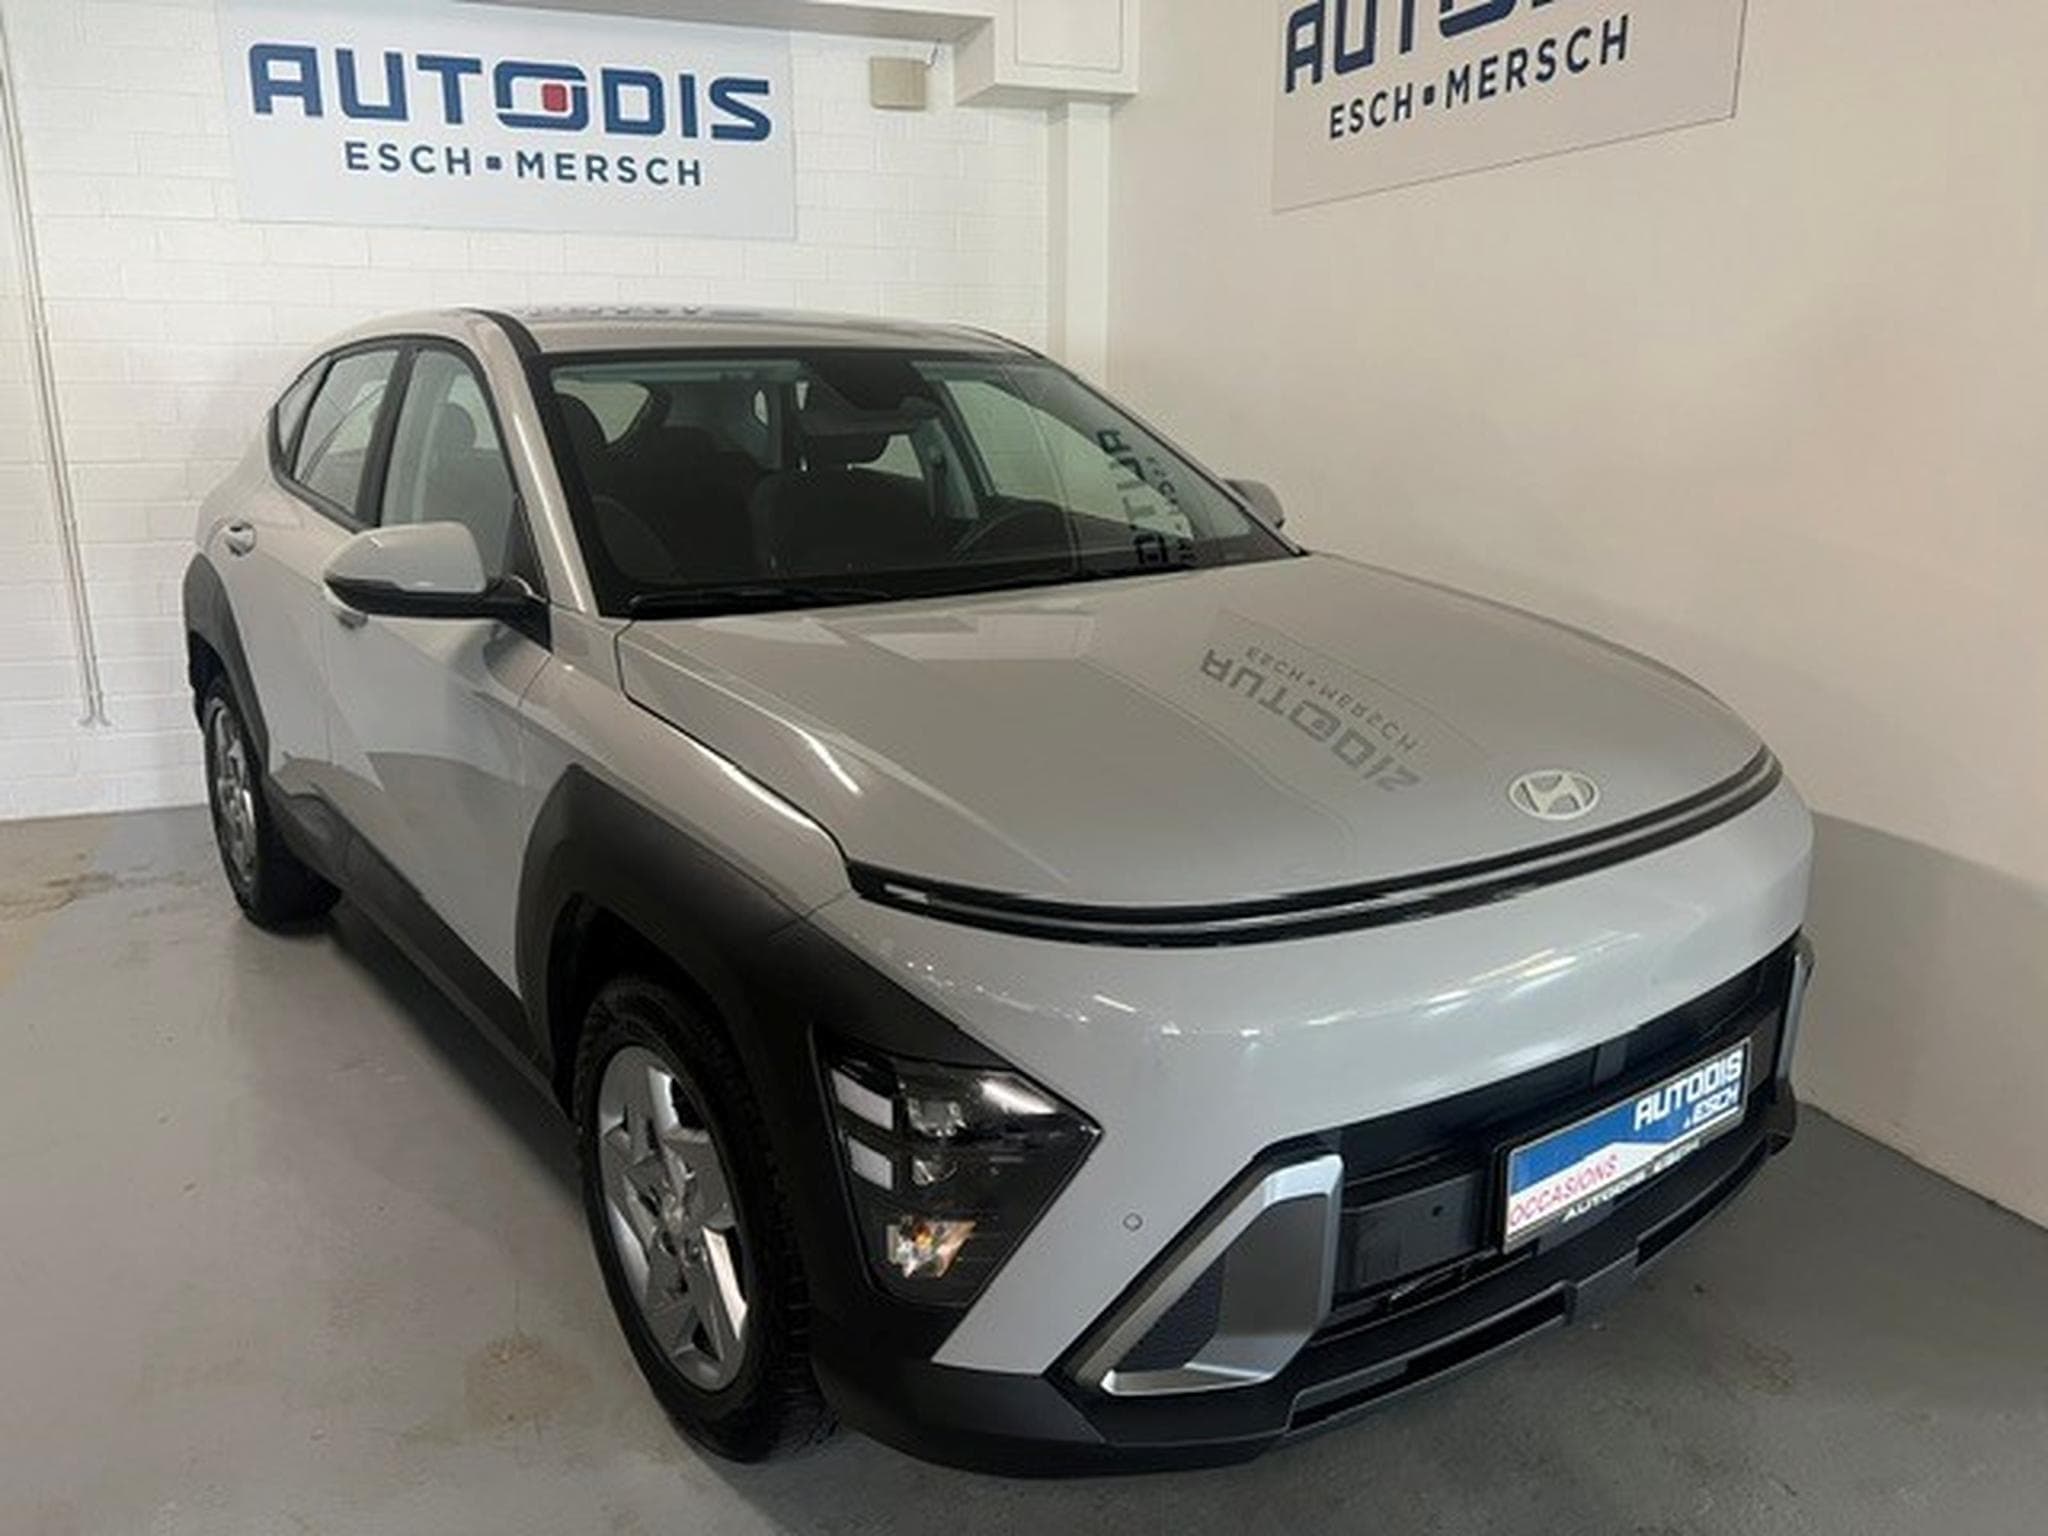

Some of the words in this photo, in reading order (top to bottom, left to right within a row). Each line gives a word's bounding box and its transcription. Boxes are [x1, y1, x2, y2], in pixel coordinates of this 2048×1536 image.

[248, 43, 773, 142] AUTODIS
[1329, 83, 1413, 139] ESCH
[1444, 15, 1629, 110] MERSCH
[345, 142, 472, 175] ESCH
[516, 154, 702, 187] MERSCH
[1633, 1049, 1744, 1131] AUTODIS
